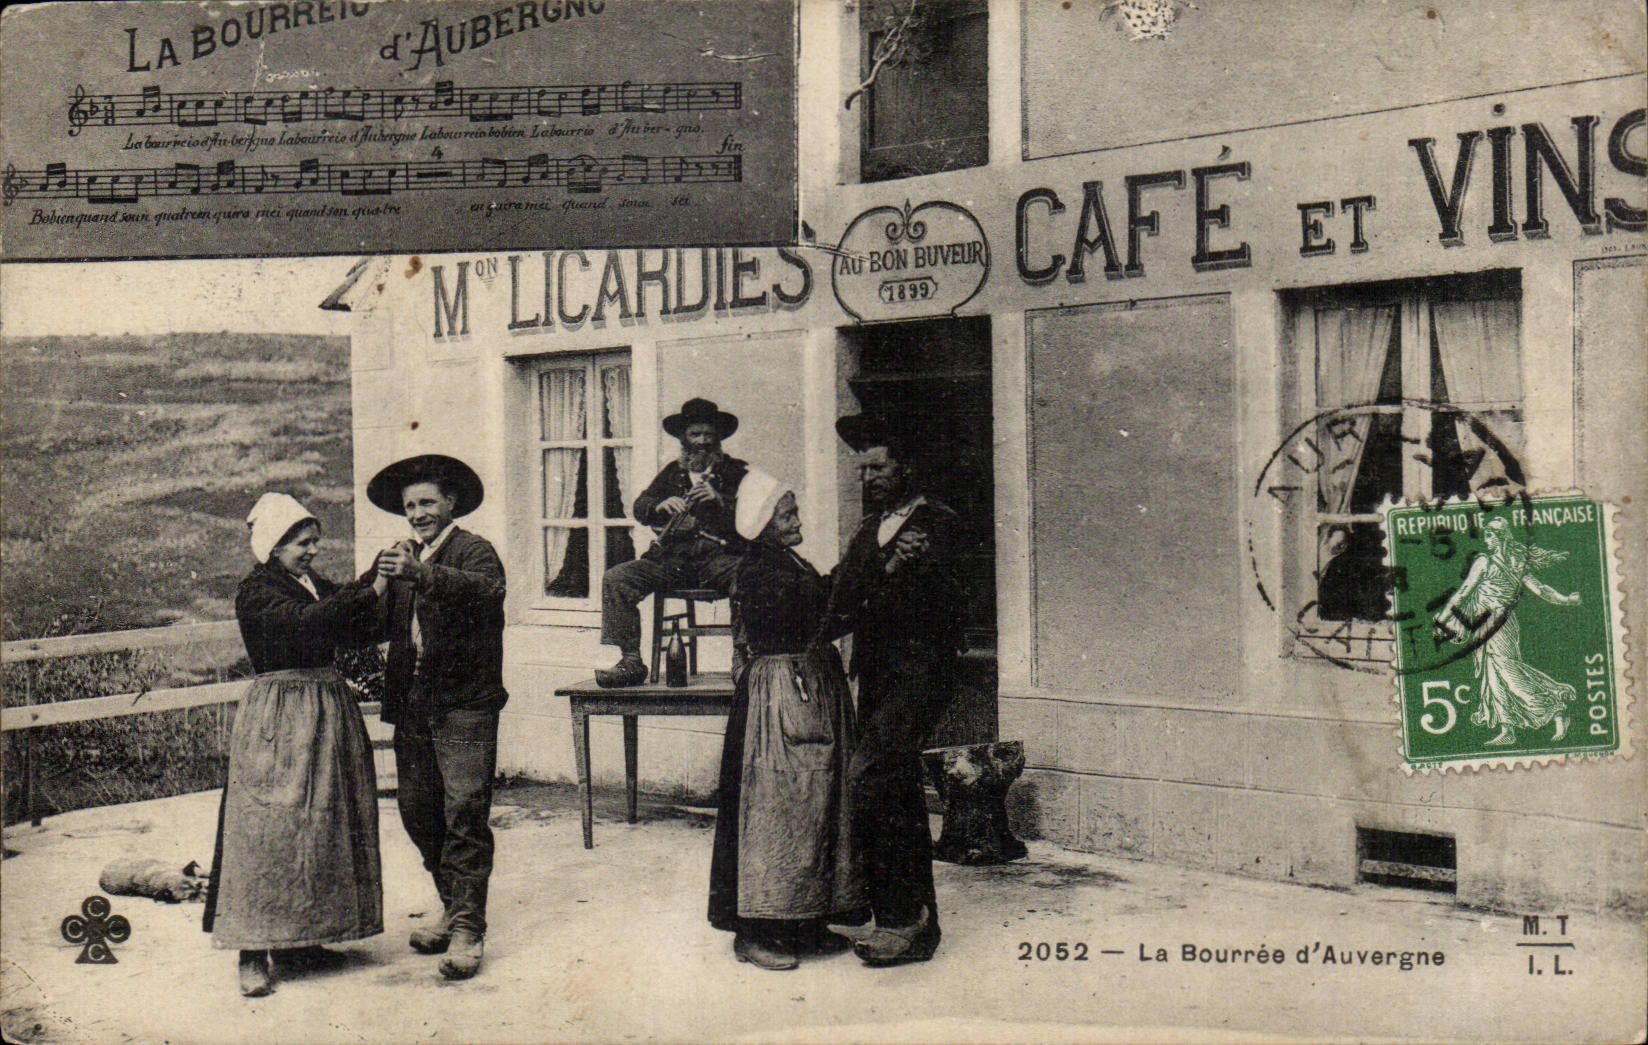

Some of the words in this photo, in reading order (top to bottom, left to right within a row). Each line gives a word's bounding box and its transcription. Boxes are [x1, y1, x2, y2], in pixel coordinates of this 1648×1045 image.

[1015, 145, 1252, 286] CAFÉ
[1297, 195, 1376, 257] ET
[1408, 101, 1648, 249] VINS
[839, 254, 865, 276] AU
[869, 248, 909, 273] BON
[914, 240, 986, 269] BUVEUR
[886, 281, 930, 301] 1899
[1585, 652, 1609, 736] POSTES
